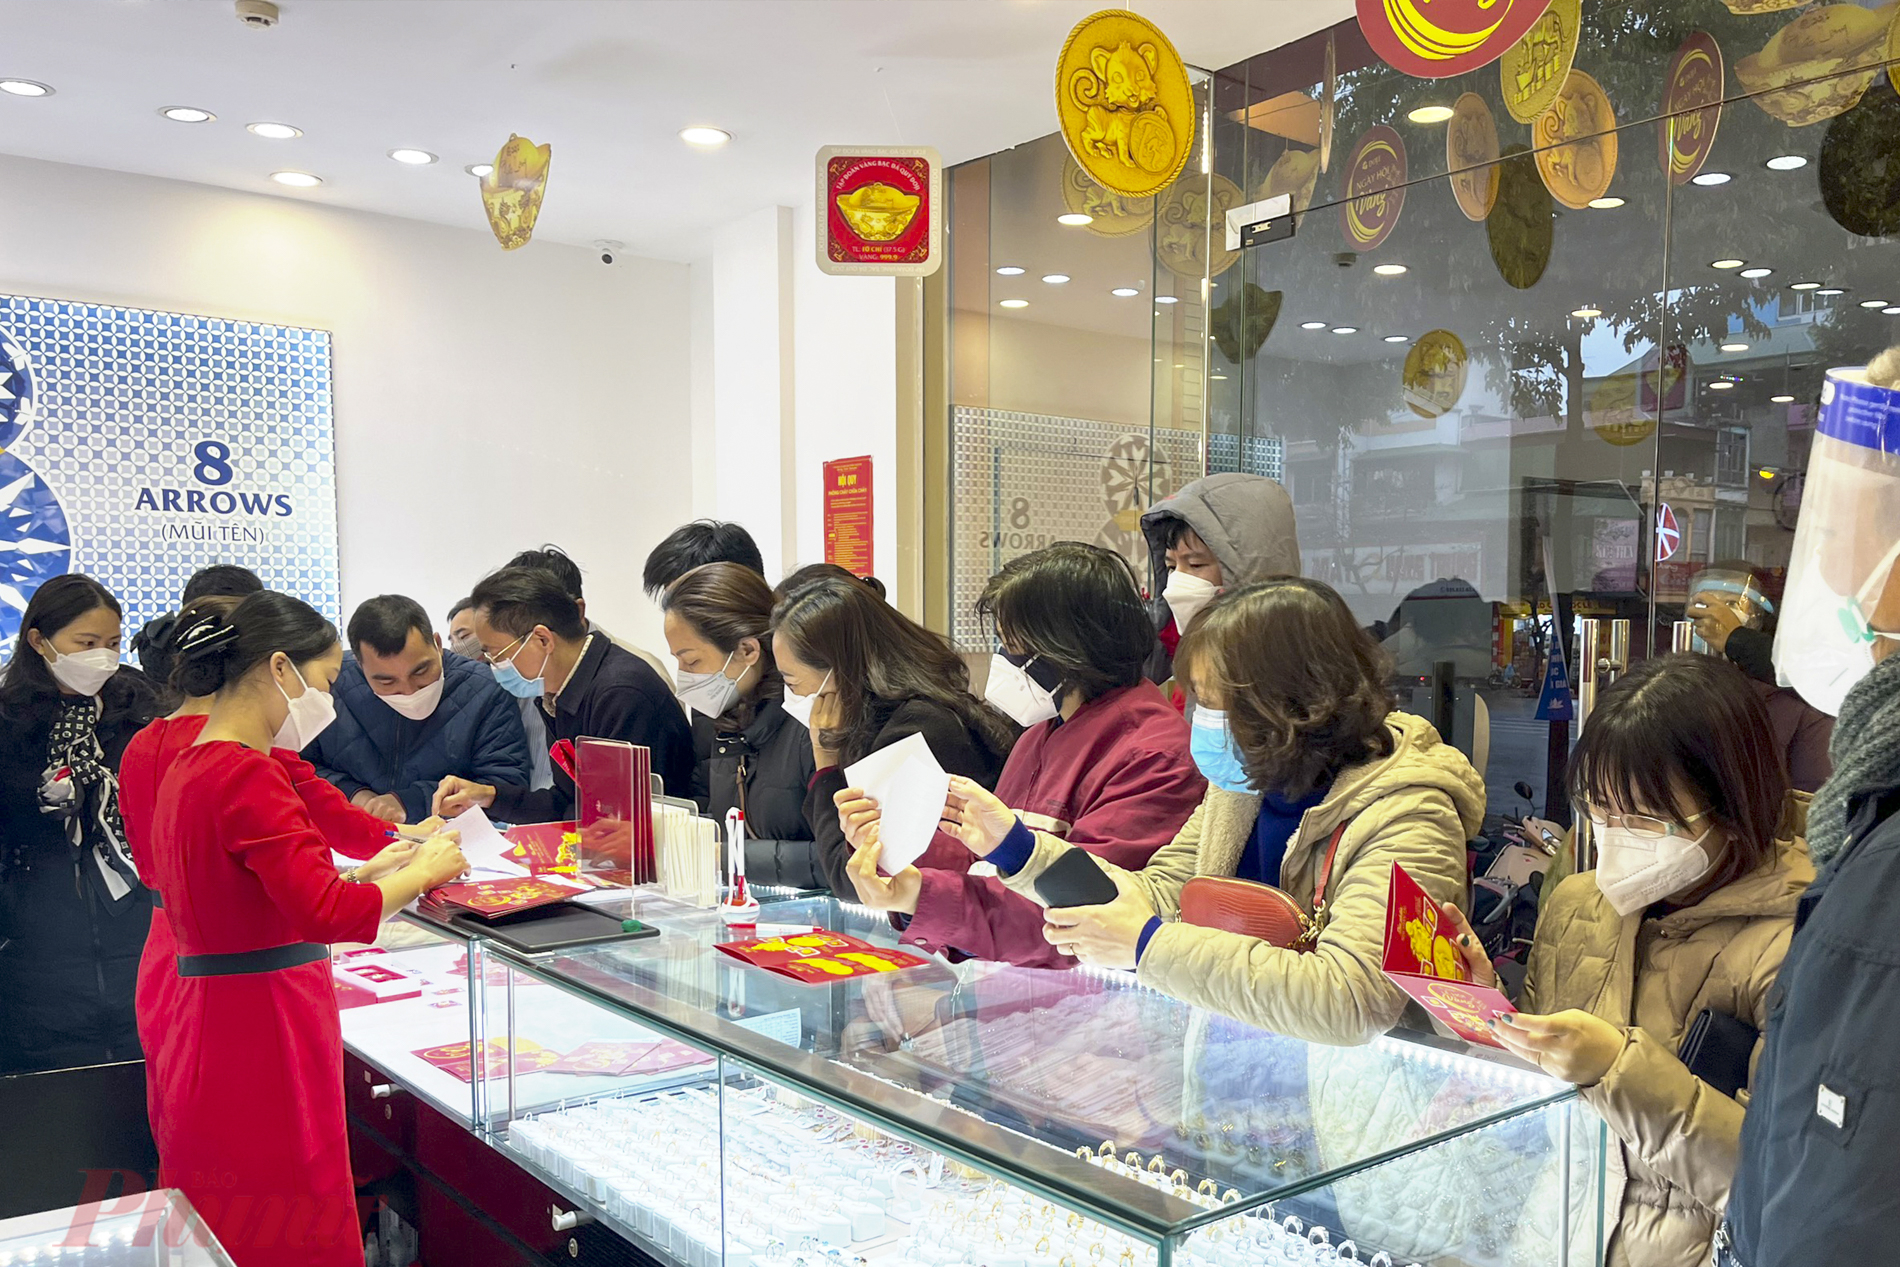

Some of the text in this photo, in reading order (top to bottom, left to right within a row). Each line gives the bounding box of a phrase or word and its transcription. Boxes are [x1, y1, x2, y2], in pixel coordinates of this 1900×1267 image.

[193, 440, 234, 486] 8
[134, 487, 293, 517] ARROWS
[161, 521, 265, 545] (MŨI TÊN)
